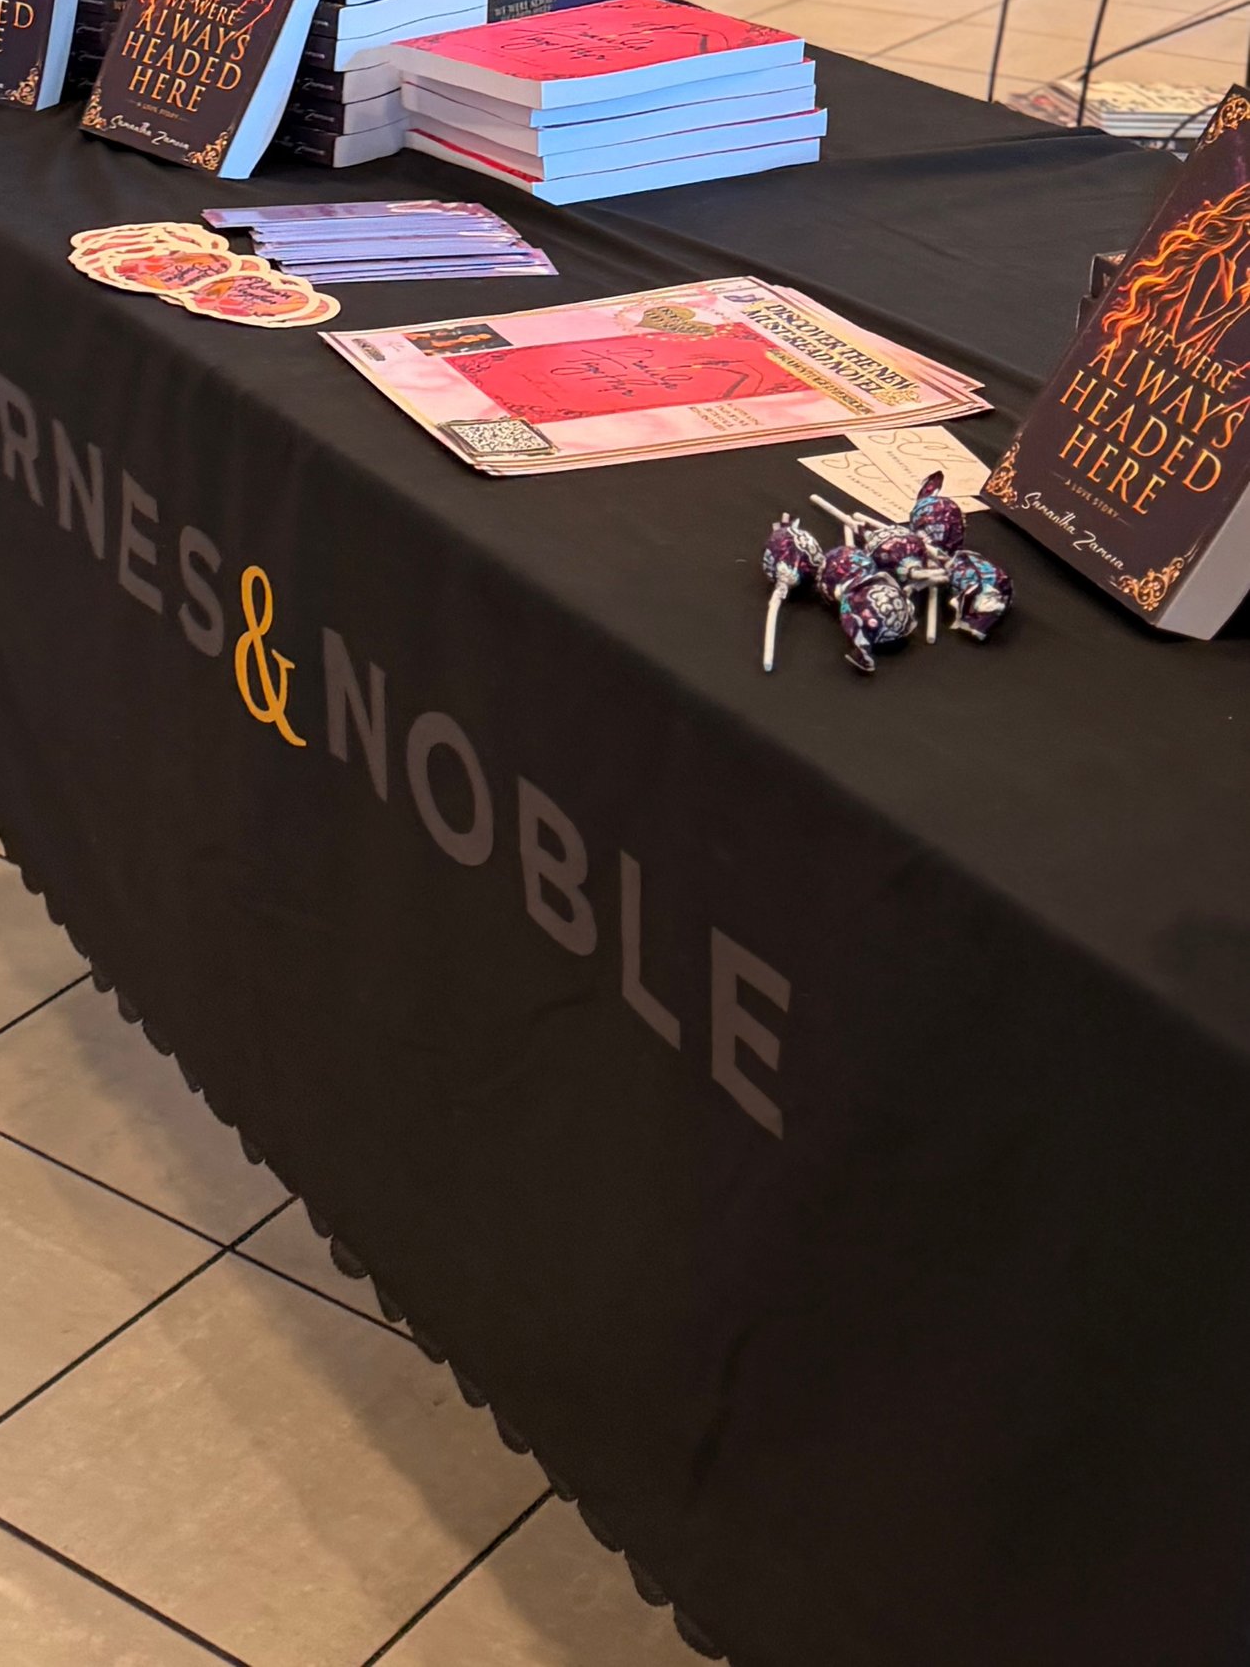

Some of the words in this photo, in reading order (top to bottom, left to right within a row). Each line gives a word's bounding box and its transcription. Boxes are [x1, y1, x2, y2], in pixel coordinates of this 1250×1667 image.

[121, 30, 242, 91] HEADED
[135, 4, 250, 61] ALWAYS
[128, 65, 207, 113] HERE
[741, 308, 833, 366] MUST-READ
[828, 356, 887, 396] NOVEL
[763, 303, 845, 351] DISCOVER
[839, 342, 878, 369] THE
[871, 360, 918, 392] NEW
[1137, 321, 1175, 355] WE
[1173, 342, 1236, 394] WERE
[1059, 369, 1222, 493] HEADED
[1088, 340, 1245, 449] ALWAYS
[1058, 424, 1166, 515] HERE
[1071, 483, 1092, 501] LOVE
[1092, 496, 1120, 519] STORY
[1021, 491, 1076, 535] Samantha
[1072, 529, 1125, 571] Zamora
[234, 565, 307, 747] &
[322, 627, 792, 1139] NOBLE
